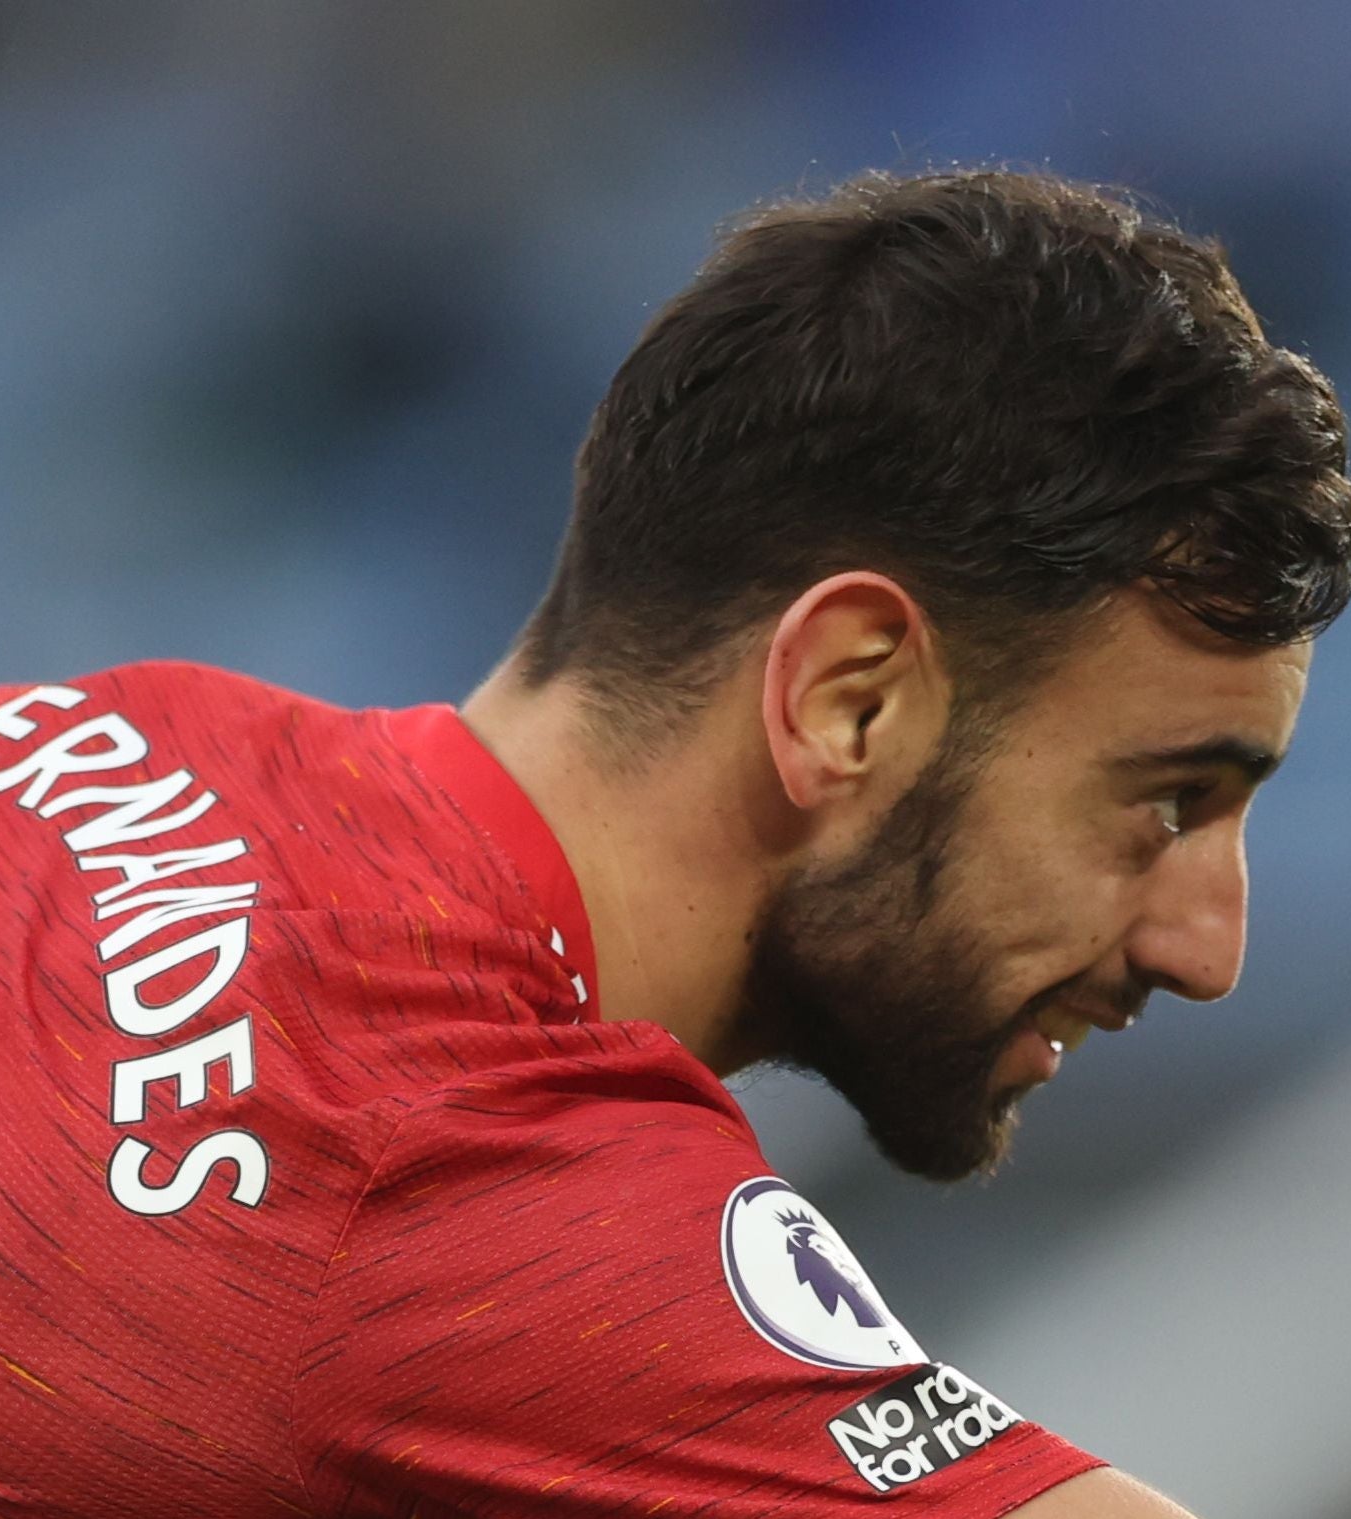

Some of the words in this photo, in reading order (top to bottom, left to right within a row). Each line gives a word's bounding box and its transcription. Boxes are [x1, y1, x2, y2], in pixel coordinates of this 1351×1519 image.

[828, 1398, 914, 1465] No
[913, 1365, 991, 1420] ro
[856, 1433, 935, 1492] for
[932, 1393, 1025, 1461] rac
